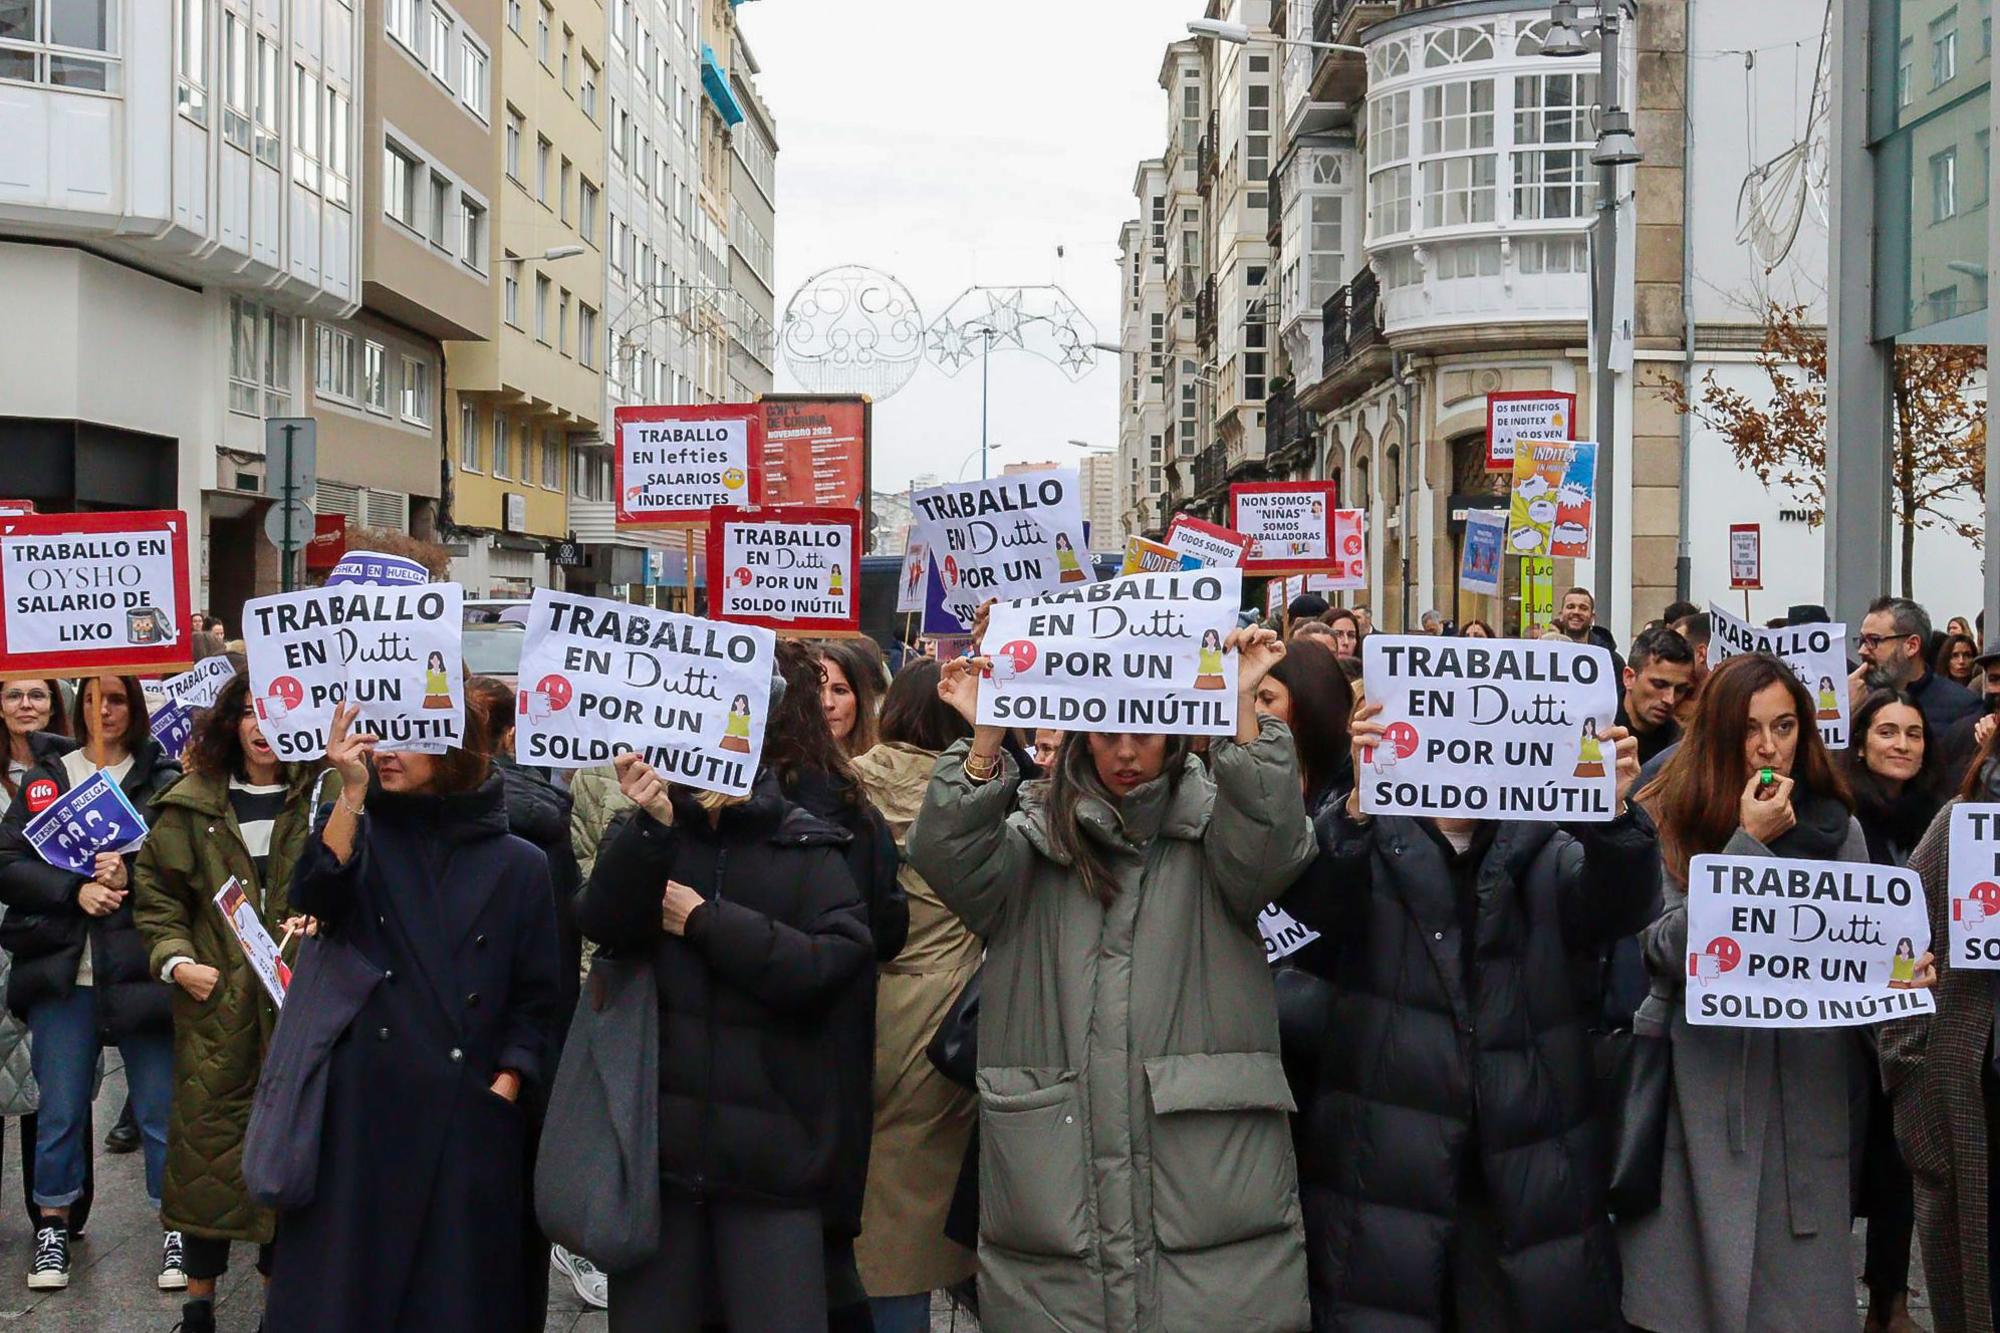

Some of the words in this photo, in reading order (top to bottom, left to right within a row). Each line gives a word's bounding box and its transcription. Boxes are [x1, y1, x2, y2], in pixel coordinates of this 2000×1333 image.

[1497, 404, 1508, 413] OS
[1510, 403, 1560, 412] BENEFICIOS
[1498, 418, 1508, 426] DE
[1510, 416, 1546, 426] INDITEX
[639, 428, 729, 444] TRABALLO
[1544, 430, 1562, 439] VEN
[633, 451, 653, 464] EN
[660, 448, 728, 464] lefties
[1494, 446, 1514, 455] DOUS
[1533, 446, 1578, 463] INDITEX
[648, 472, 721, 486] SALARIOS
[638, 493, 729, 507] INDECENTES
[916, 479, 1064, 522] TRABALLO
[1242, 498, 1268, 506] NON
[1270, 496, 1312, 506] SOMOS
[1256, 507, 1306, 519] "NIÑAS"
[734, 528, 841, 548] TRABALLO
[946, 529, 966, 551] EN
[966, 520, 1048, 554] Dutti
[1262, 522, 1299, 531] SOMOS
[12, 541, 130, 562] TRABALLO
[138, 540, 166, 556] EN
[746, 551, 770, 566] EN
[775, 548, 828, 570] Dutti
[1177, 532, 1204, 548] TODOS
[1204, 542, 1235, 558] SOMOS
[28, 564, 141, 591] OYSHO
[334, 565, 362, 575] SHKA
[368, 565, 381, 576] EN
[386, 566, 426, 584] HUELGA
[756, 576, 791, 589] POR
[794, 576, 818, 590] UN
[960, 566, 999, 589] POR
[1003, 559, 1042, 582] UN
[17, 593, 116, 614] SALARIO
[124, 591, 150, 608] DE
[254, 592, 445, 636] TRABALLO
[731, 598, 786, 612] SOLDO
[790, 596, 846, 614] INÚTIL
[60, 623, 112, 642] LIXO
[548, 602, 756, 664] TRABALLO
[1028, 614, 1075, 637] EN
[1088, 606, 1192, 640] Dutti
[1710, 609, 1831, 657] TRABALLO
[284, 639, 327, 670] EN
[333, 628, 418, 667] Dutti
[166, 662, 220, 699] TRABALLO
[218, 660, 232, 675] EN
[564, 646, 612, 675] EN
[623, 651, 722, 701] Dutti
[1045, 652, 1113, 678] POR
[1123, 654, 1173, 680] UN
[1382, 646, 1599, 685] TRABALLO
[311, 681, 348, 708] PO
[355, 678, 401, 702] UN
[1408, 690, 1454, 718] EN
[1467, 684, 1574, 726] Dutti
[578, 693, 644, 724] POR
[654, 706, 703, 734] UN
[993, 696, 1107, 723] SOLDO
[1118, 693, 1230, 726] INÚTIL
[277, 728, 328, 754] SOL
[355, 714, 459, 742] INÚTIL
[530, 732, 634, 760] SOLDO
[644, 746, 748, 788] INÚTIL
[1426, 739, 1494, 766] POR
[1504, 742, 1554, 767] UN
[1374, 782, 1488, 810] SOLDO
[1500, 780, 1610, 813] INÚTIL
[32, 818, 62, 846] BERSHKA
[58, 807, 73, 823] EN
[72, 781, 109, 812] HUELGA
[1706, 865, 1912, 907] TRABALLO
[1732, 906, 1776, 934] EN
[1788, 904, 1888, 946] Dutti
[1748, 954, 1812, 980] POR
[1820, 958, 1867, 983] UN
[1701, 993, 1808, 1020] SOLDO
[1818, 992, 1928, 1020] INÚTIL
